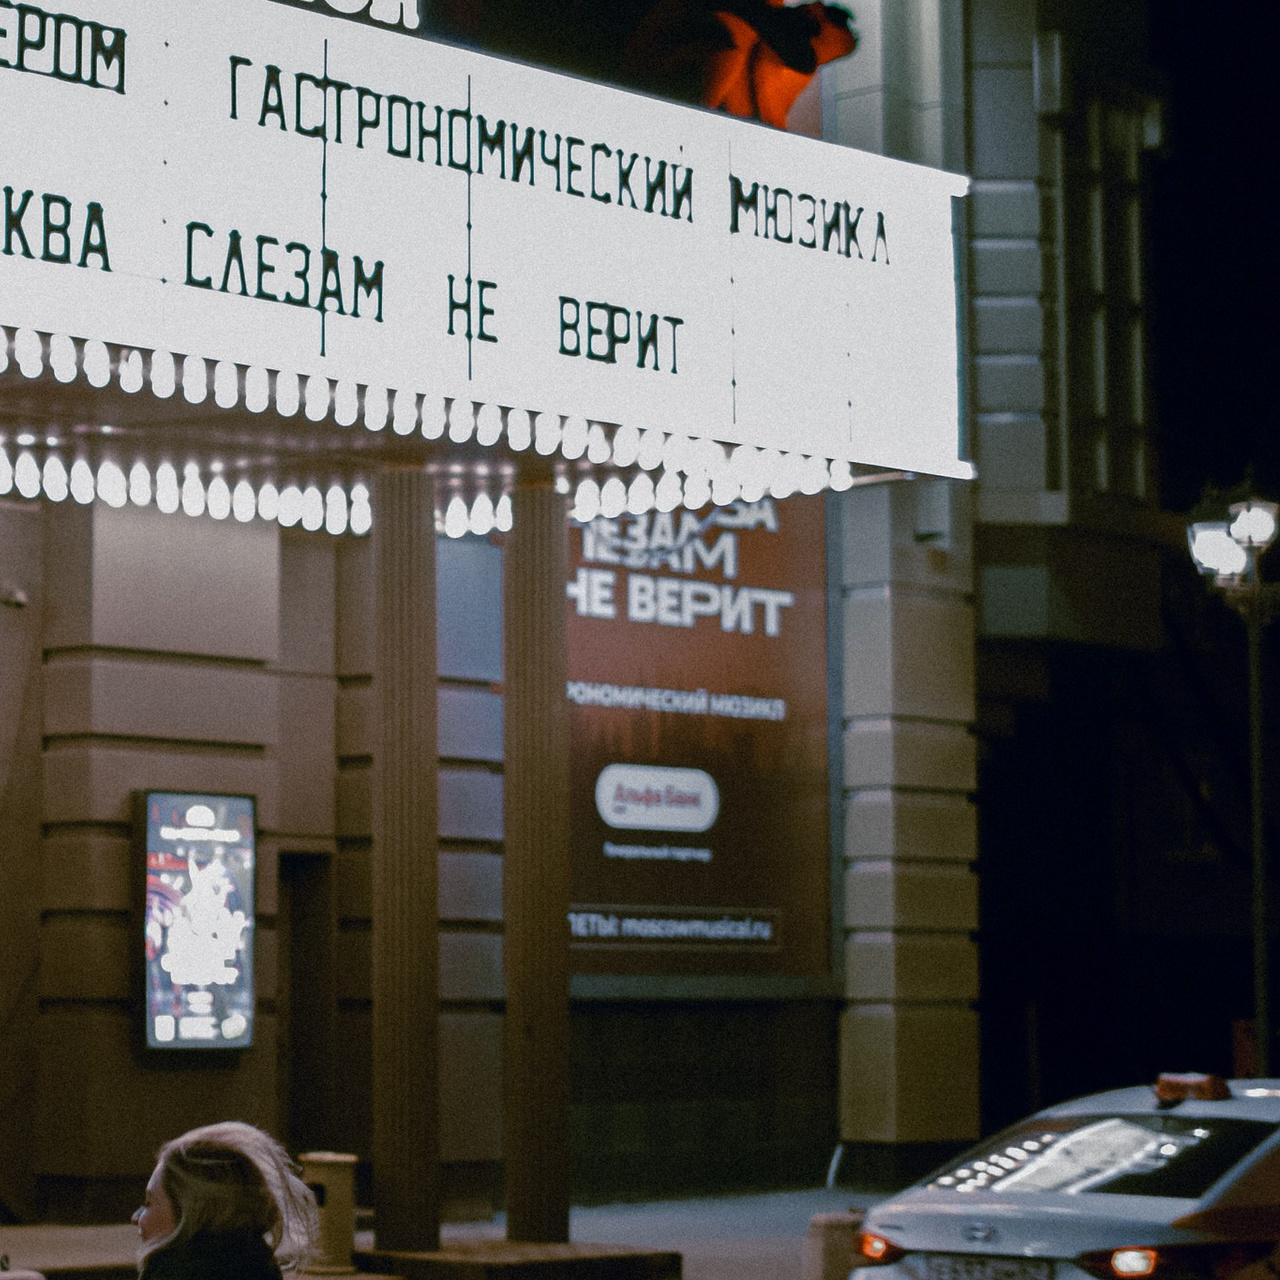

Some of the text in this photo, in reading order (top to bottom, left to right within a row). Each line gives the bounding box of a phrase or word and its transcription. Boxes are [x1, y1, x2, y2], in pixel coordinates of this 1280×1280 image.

[728, 173, 891, 266] МЮЗИКЛ
[185, 220, 385, 323] СЛЕЗАМ
[446, 273, 499, 343] НЕ
[558, 295, 685, 375] ВЕРИТ
[626, 573, 795, 638] ВЕРИТ
